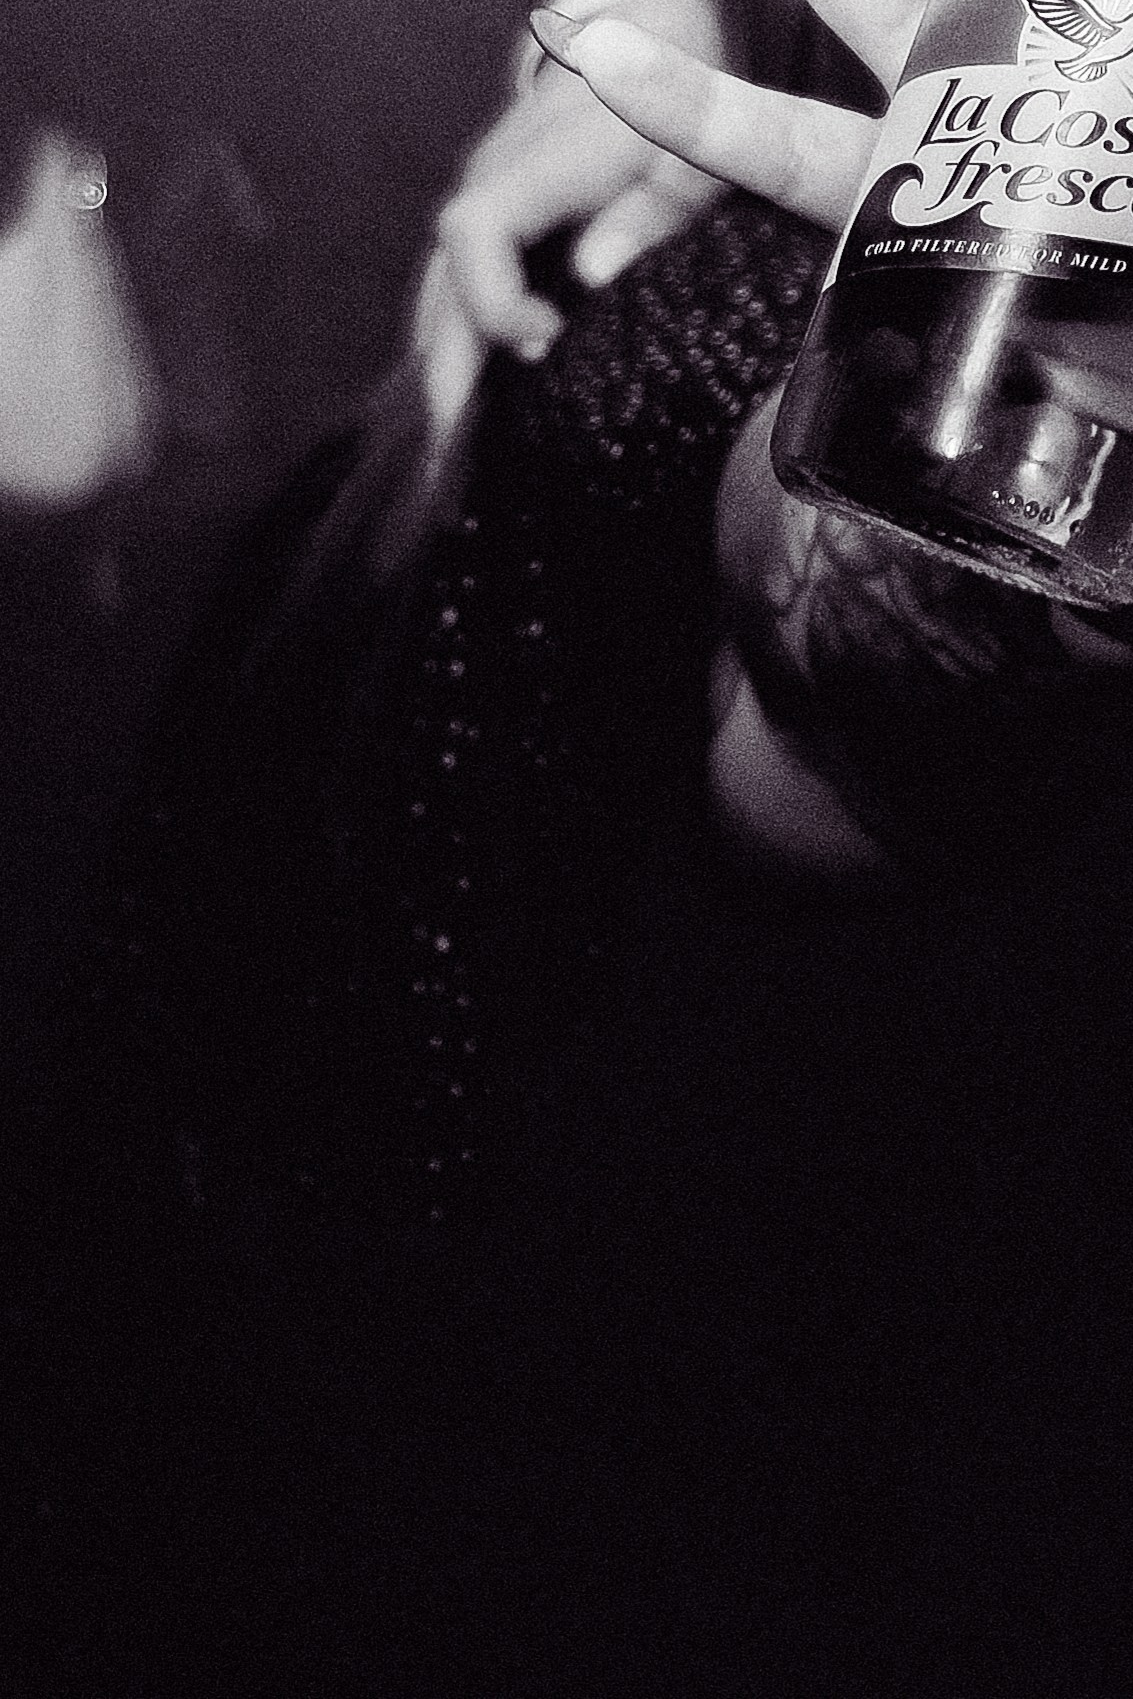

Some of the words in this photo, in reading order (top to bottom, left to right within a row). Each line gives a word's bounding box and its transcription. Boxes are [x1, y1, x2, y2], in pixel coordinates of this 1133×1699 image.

[915, 77, 994, 156] La
[865, 238, 905, 258] COLD
[911, 238, 1010, 258] FILTERED
[1069, 252, 1128, 274] MILD
